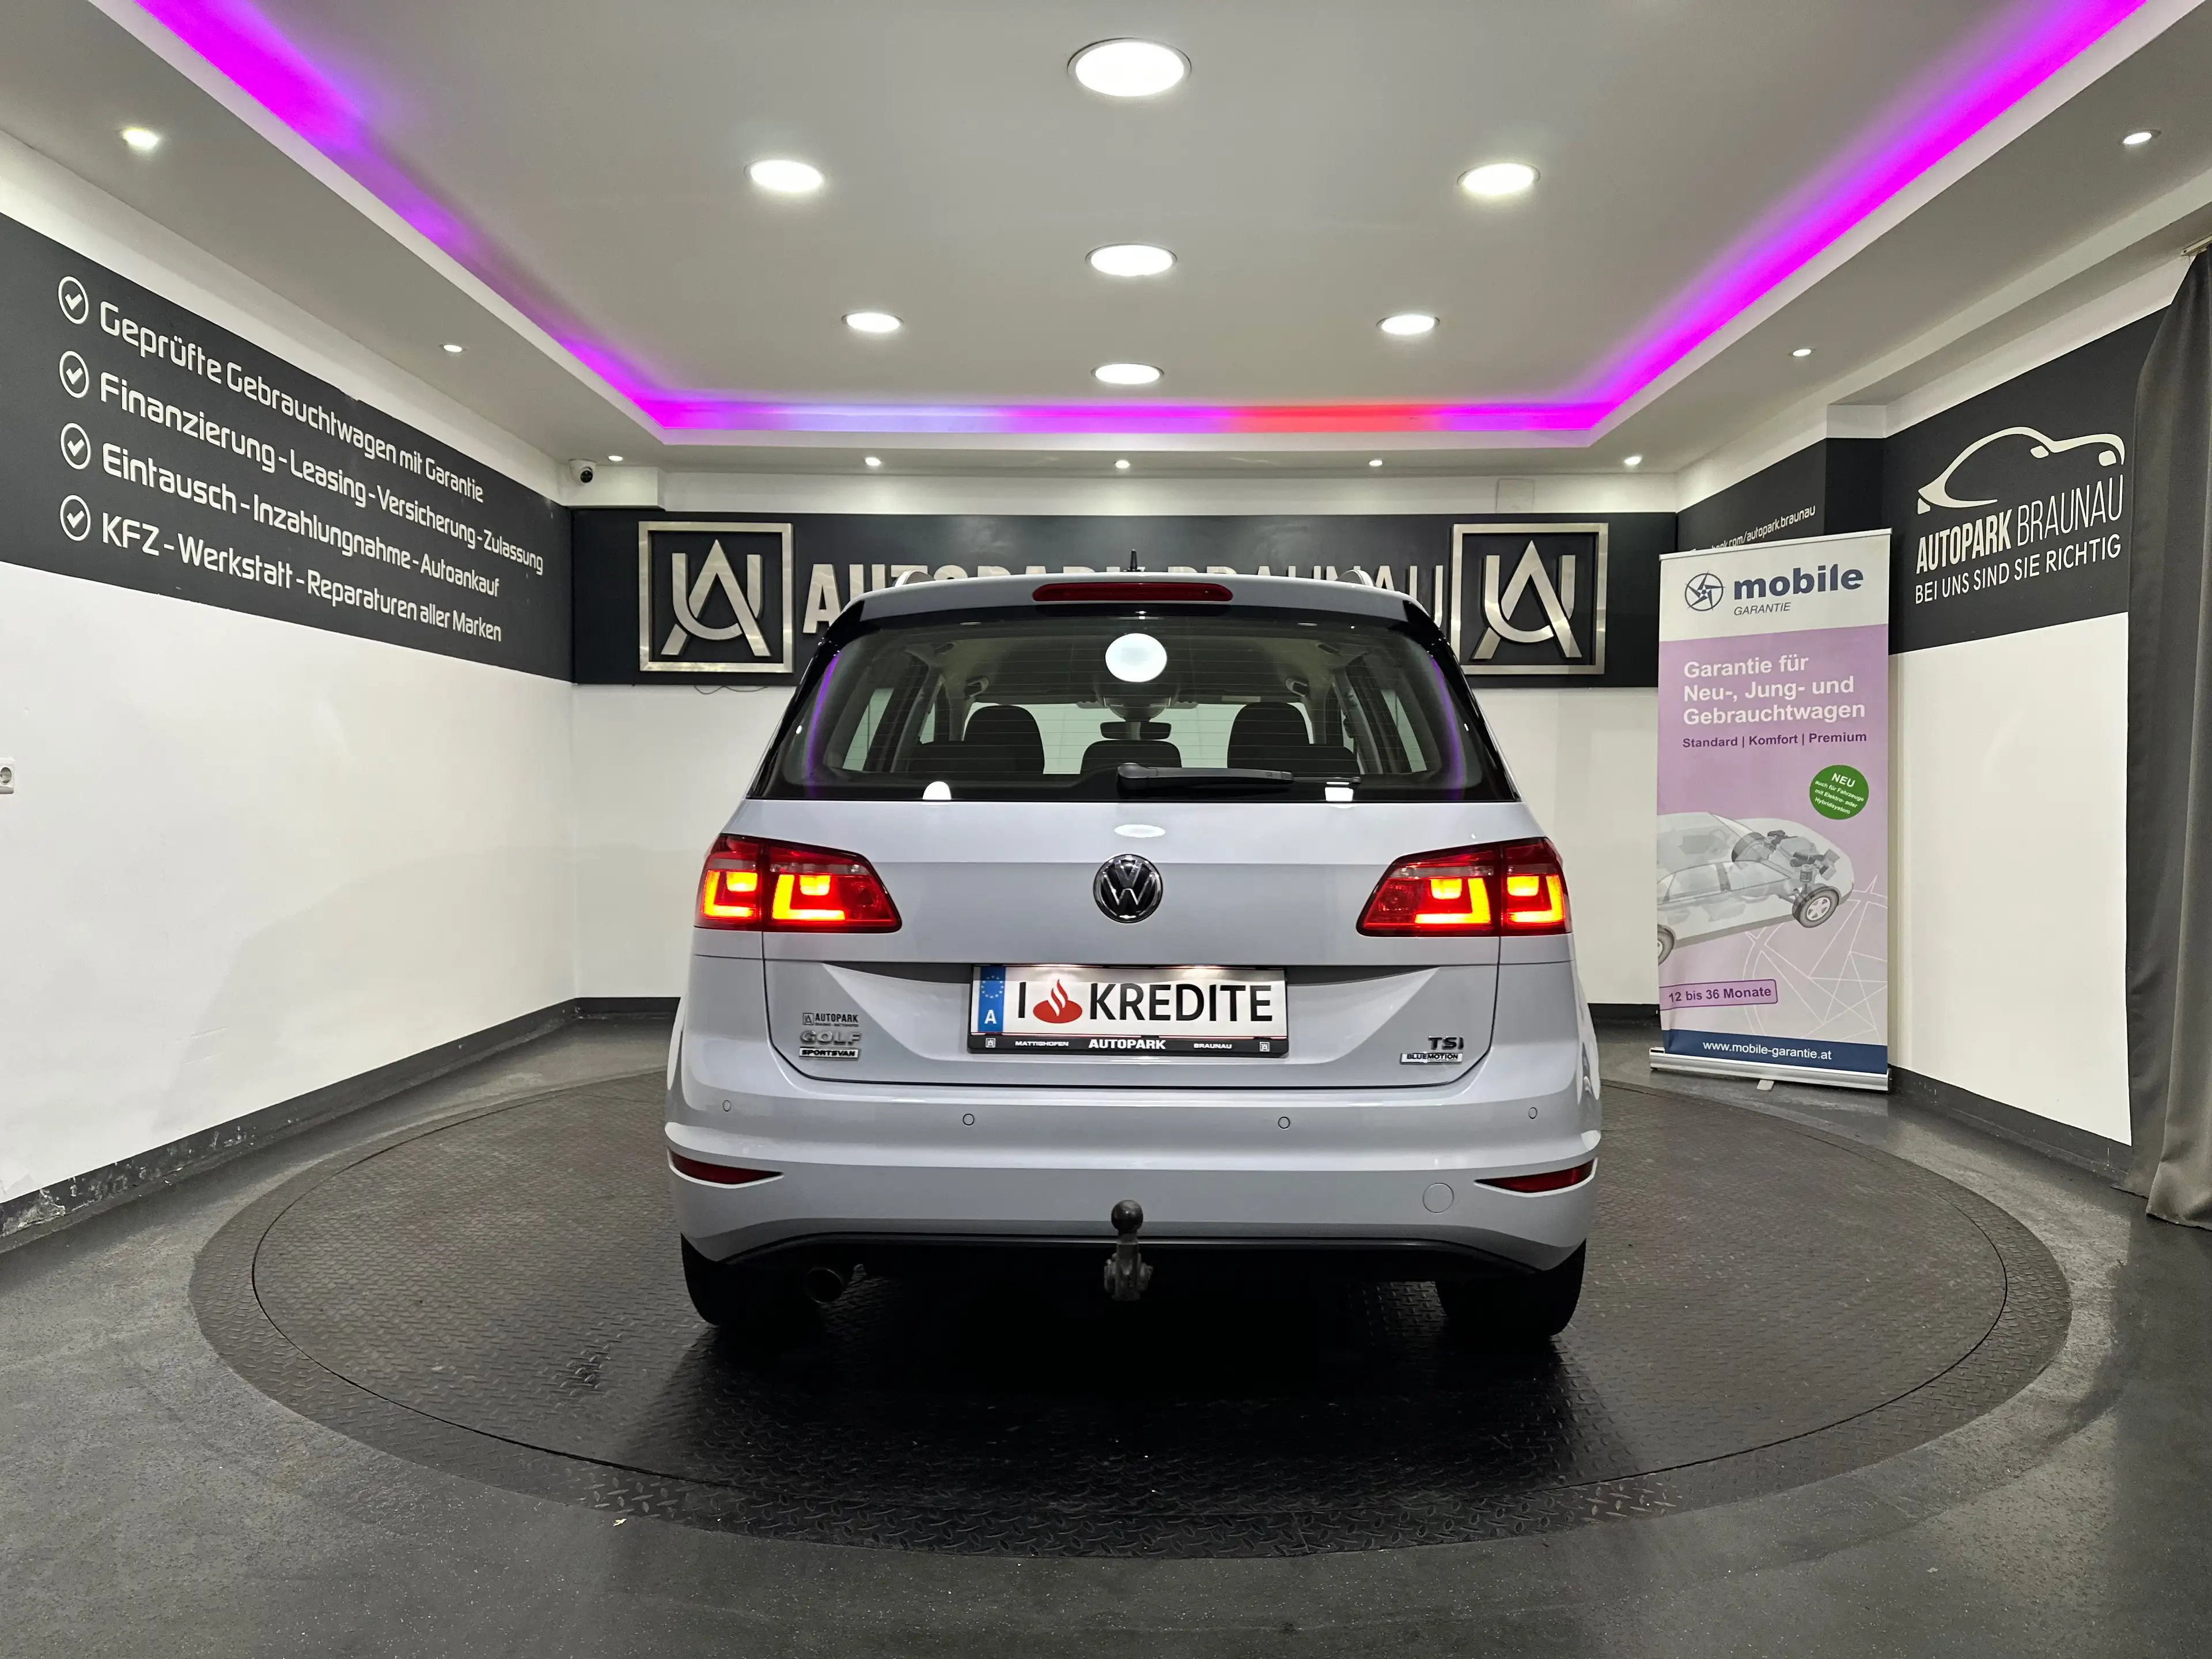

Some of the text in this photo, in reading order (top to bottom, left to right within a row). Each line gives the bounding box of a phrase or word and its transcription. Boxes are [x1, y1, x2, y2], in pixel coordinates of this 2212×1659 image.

[100, 301, 484, 503] Geprüfte Gebrauchtwagen mit Garantie
[1916, 475, 2123, 574] AUTOPARK BRAUNAU
[1915, 533, 2122, 605] BEI UNS SIND SIE RICHTIG
[1734, 563, 1863, 600] mobile
[1734, 602, 1791, 615] GARANTIE
[420, 603, 450, 629] aller
[452, 609, 501, 642] Marken
[1684, 654, 1809, 678] Garantie für
[1684, 676, 1854, 702] Neu-, Jung- und
[1683, 704, 1865, 725] Gebrauchtwagen
[1683, 737, 1738, 748] Standard
[1749, 734, 1798, 746] Komfort
[1809, 732, 1867, 743] Premium
[1815, 781, 1828, 789] auch
[1832, 773, 1855, 787] NEU
[1844, 800, 1858, 808] oder
[1018, 982, 1272, 1022] I KREDITE
[1669, 987, 1772, 1003] 12 bis 36 Monate
[815, 1013, 858, 1023] AUTOPARK
[984, 1009, 997, 1024] A
[800, 1029, 862, 1046] GOLF
[1088, 1039, 1166, 1050] AUTOPARK
[1428, 1036, 1464, 1050] TSI
[1703, 1041, 1832, 1060] www.mobile-garantie.at
